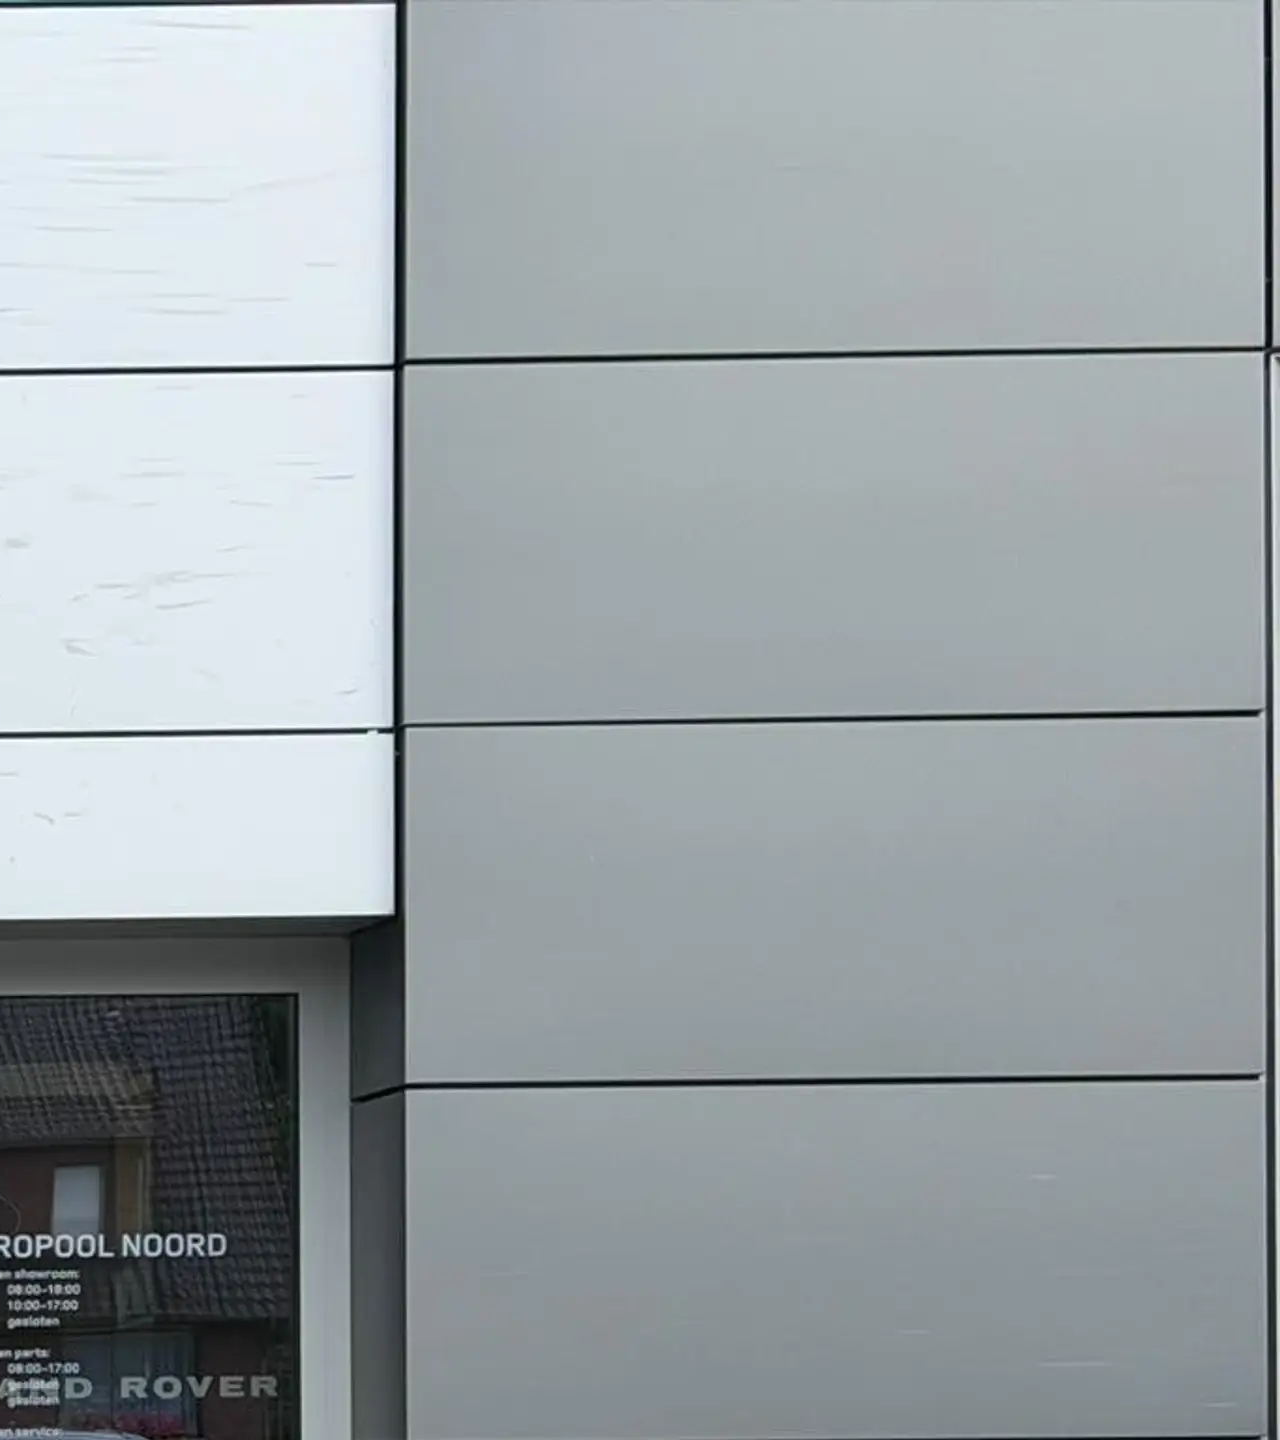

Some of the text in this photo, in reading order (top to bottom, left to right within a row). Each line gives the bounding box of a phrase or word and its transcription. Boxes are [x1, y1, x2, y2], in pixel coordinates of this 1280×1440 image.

[121, 1232, 228, 1258] NOORD
[7, 1299, 79, 1311] 10:00-17:00
[7, 1316, 61, 1330] gesloten
[120, 1374, 279, 1399] ROVER
